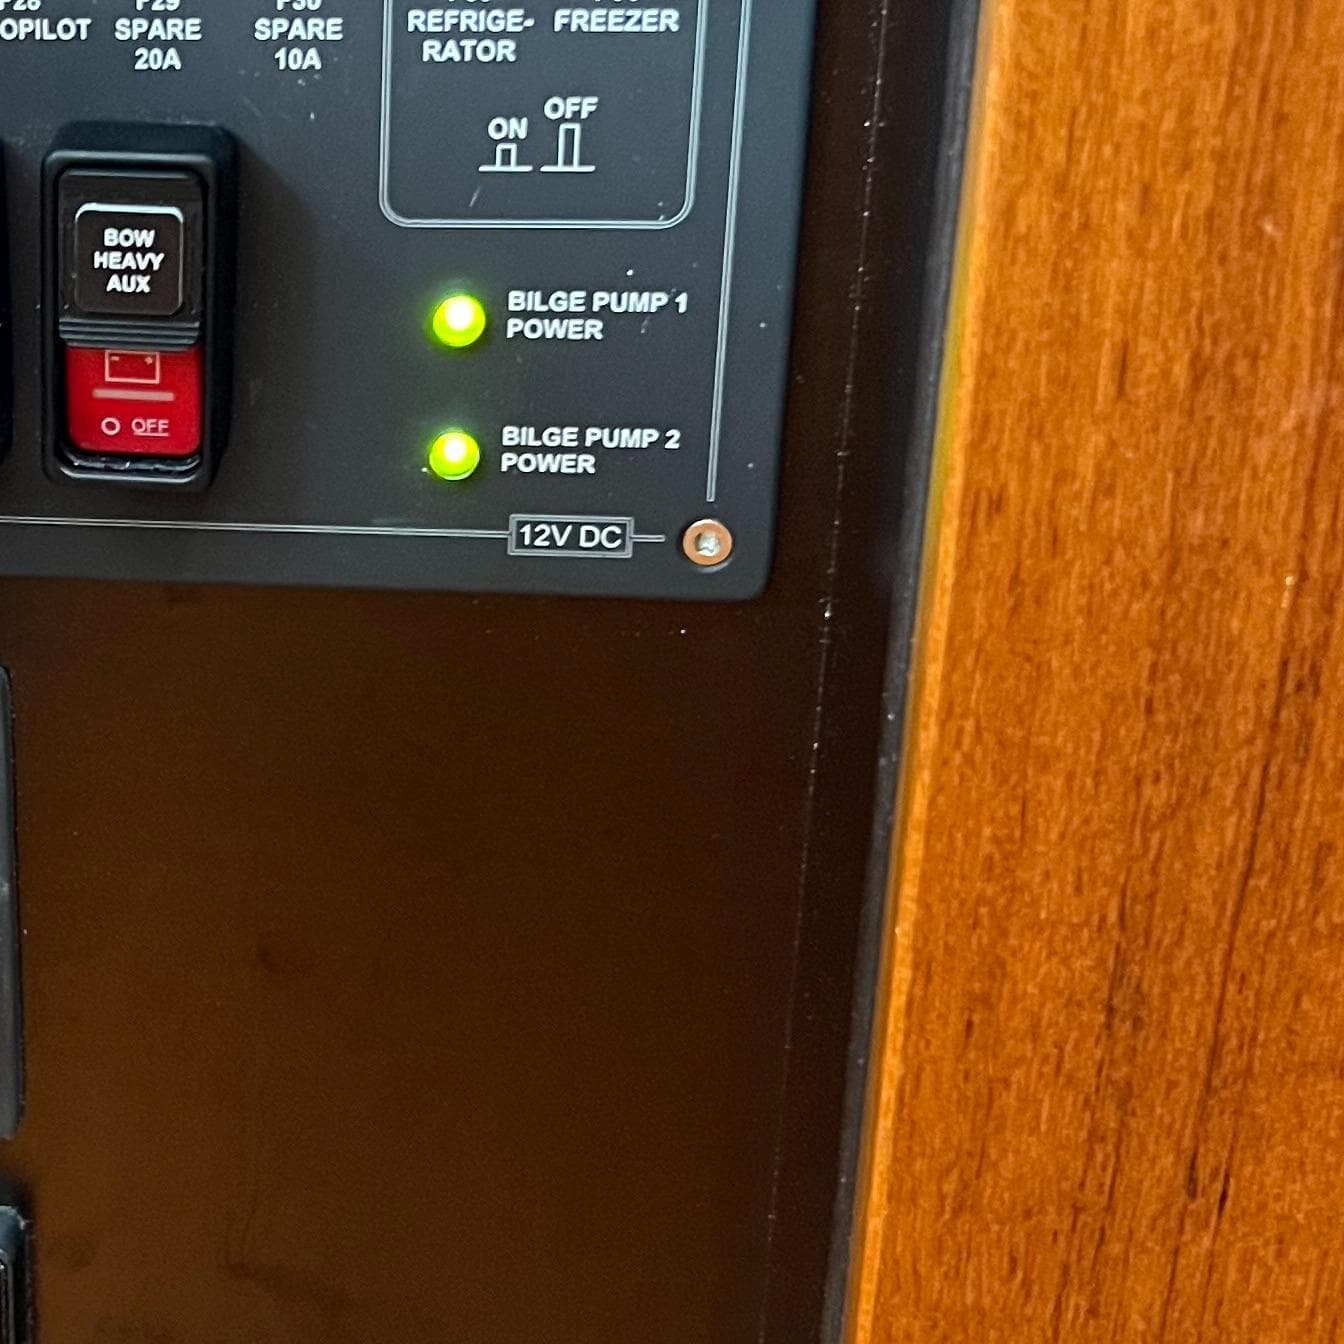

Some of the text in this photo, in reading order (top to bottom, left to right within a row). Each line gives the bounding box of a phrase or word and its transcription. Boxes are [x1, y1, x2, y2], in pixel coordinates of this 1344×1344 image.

[114, 17, 203, 41] SPARE
[254, 16, 344, 41] SPARE
[407, 8, 535, 33] REFRIGE-
[553, 7, 680, 33] FREEZER
[134, 47, 182, 70] 20A
[274, 47, 322, 70] 10A
[422, 38, 517, 63] RATOR
[543, 96, 599, 120] OFF
[487, 116, 528, 140] ON
[103, 227, 156, 248] BOW
[93, 250, 165, 271] HEAVY
[106, 273, 151, 293] AUX
[507, 290, 688, 314] BILGE PUMP 1
[506, 317, 604, 340] POWER
[131, 418, 169, 436] OFF
[502, 425, 681, 449] BILGE PUMP 2
[500, 452, 596, 474] POWER
[519, 524, 622, 549] 12V DC
